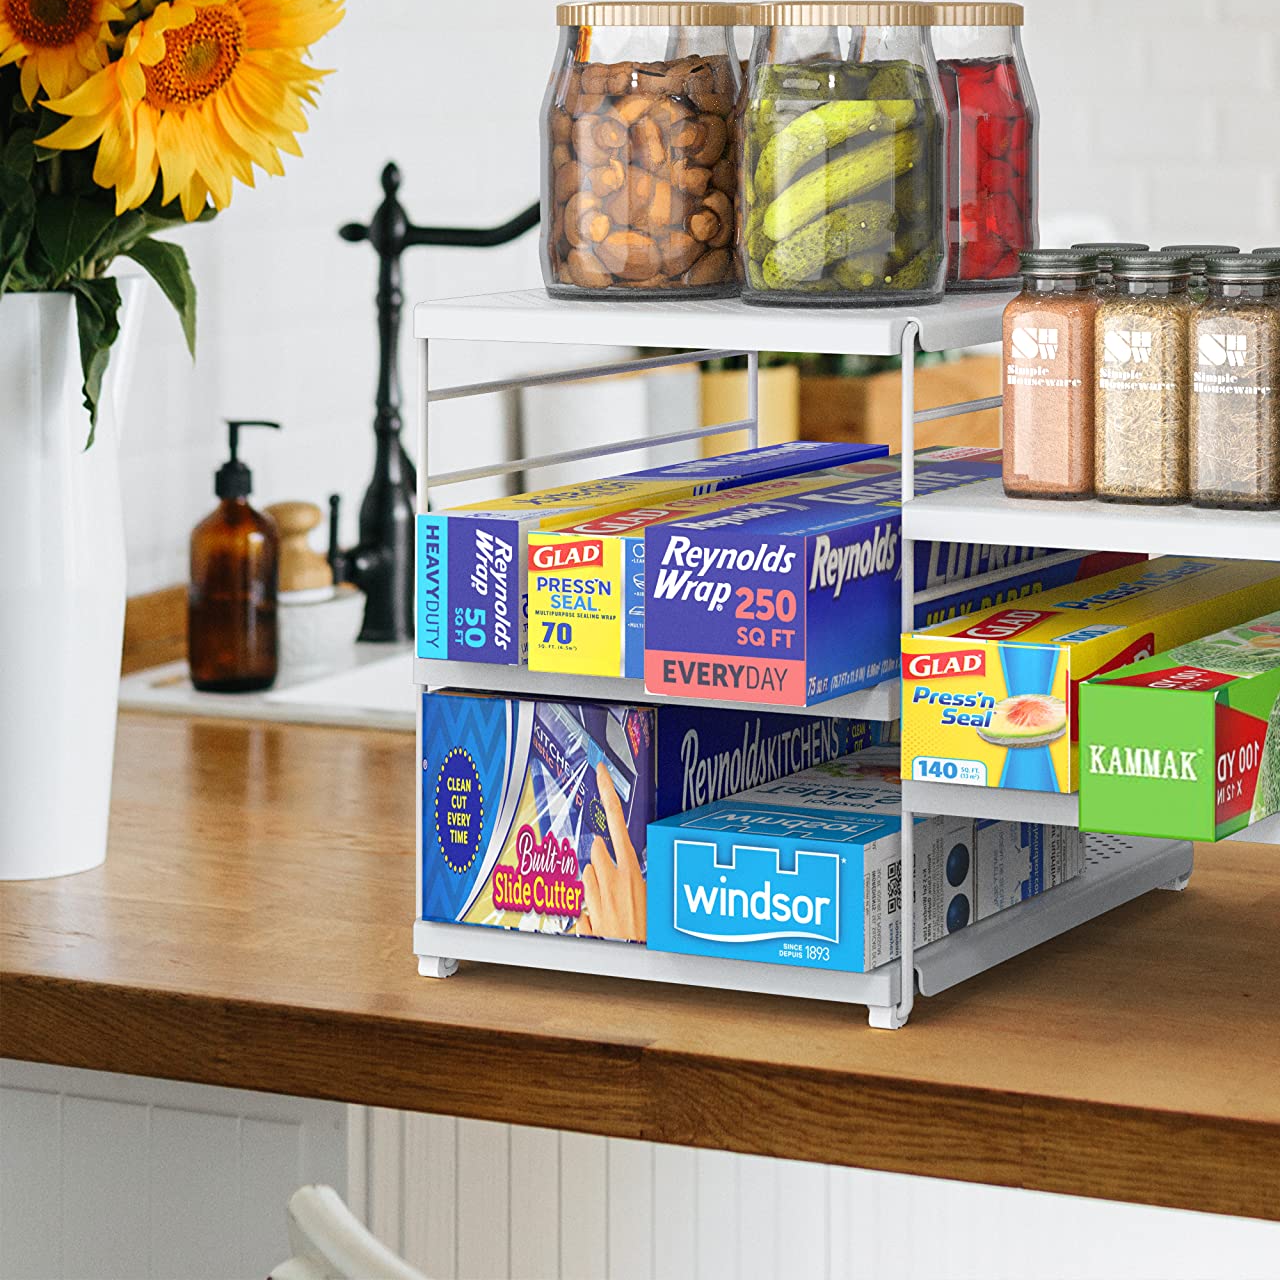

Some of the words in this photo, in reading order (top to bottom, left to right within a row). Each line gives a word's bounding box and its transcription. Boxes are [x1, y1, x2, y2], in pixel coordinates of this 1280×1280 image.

[1007, 364, 1049, 376] Simple
[1100, 367, 1142, 379] Simple
[1193, 372, 1238, 384] Simple
[1007, 375, 1081, 387] Houseware
[1100, 379, 1176, 391] Houseware
[1193, 382, 1271, 395] Houseware
[573, 508, 670, 534] GLAD
[471, 528, 495, 597] Wrap
[533, 544, 600, 569] GLAD
[661, 535, 796, 577] Reynolds
[808, 522, 898, 598] Reynolds
[494, 536, 513, 651] Reynolds
[536, 576, 611, 596] PRESS'N
[653, 568, 732, 612] Wrap
[550, 594, 599, 612] SEAL
[735, 586, 797, 623] 250
[455, 607, 464, 626] SQ
[535, 610, 576, 619] MULTIPURPOSE
[576, 611, 600, 620] SEALING
[601, 613, 617, 621] WRAP
[966, 610, 1045, 638] GLAD
[455, 630, 464, 646] FT
[465, 608, 487, 649] 50
[542, 621, 573, 645] 70
[736, 626, 766, 648] SQ
[771, 629, 796, 649] FT
[663, 659, 788, 692] EVERYDAY
[909, 655, 982, 677] GLAD
[912, 686, 995, 710] Press'n
[941, 708, 993, 729] Seal
[918, 760, 958, 779] 140
[1089, 744, 1198, 782] KAMMAK
[447, 777, 472, 793] CLEAN
[451, 795, 467, 811] CUT
[447, 813, 472, 828] EVERY
[450, 829, 469, 845] TIME
[517, 833, 576, 876] Built-in
[495, 873, 532, 906] Slide
[533, 877, 583, 911] Cutter
[683, 875, 831, 926] windsor
[779, 950, 803, 959] DEPUIS
[783, 942, 803, 952] SINCE
[805, 945, 830, 962] 1893
